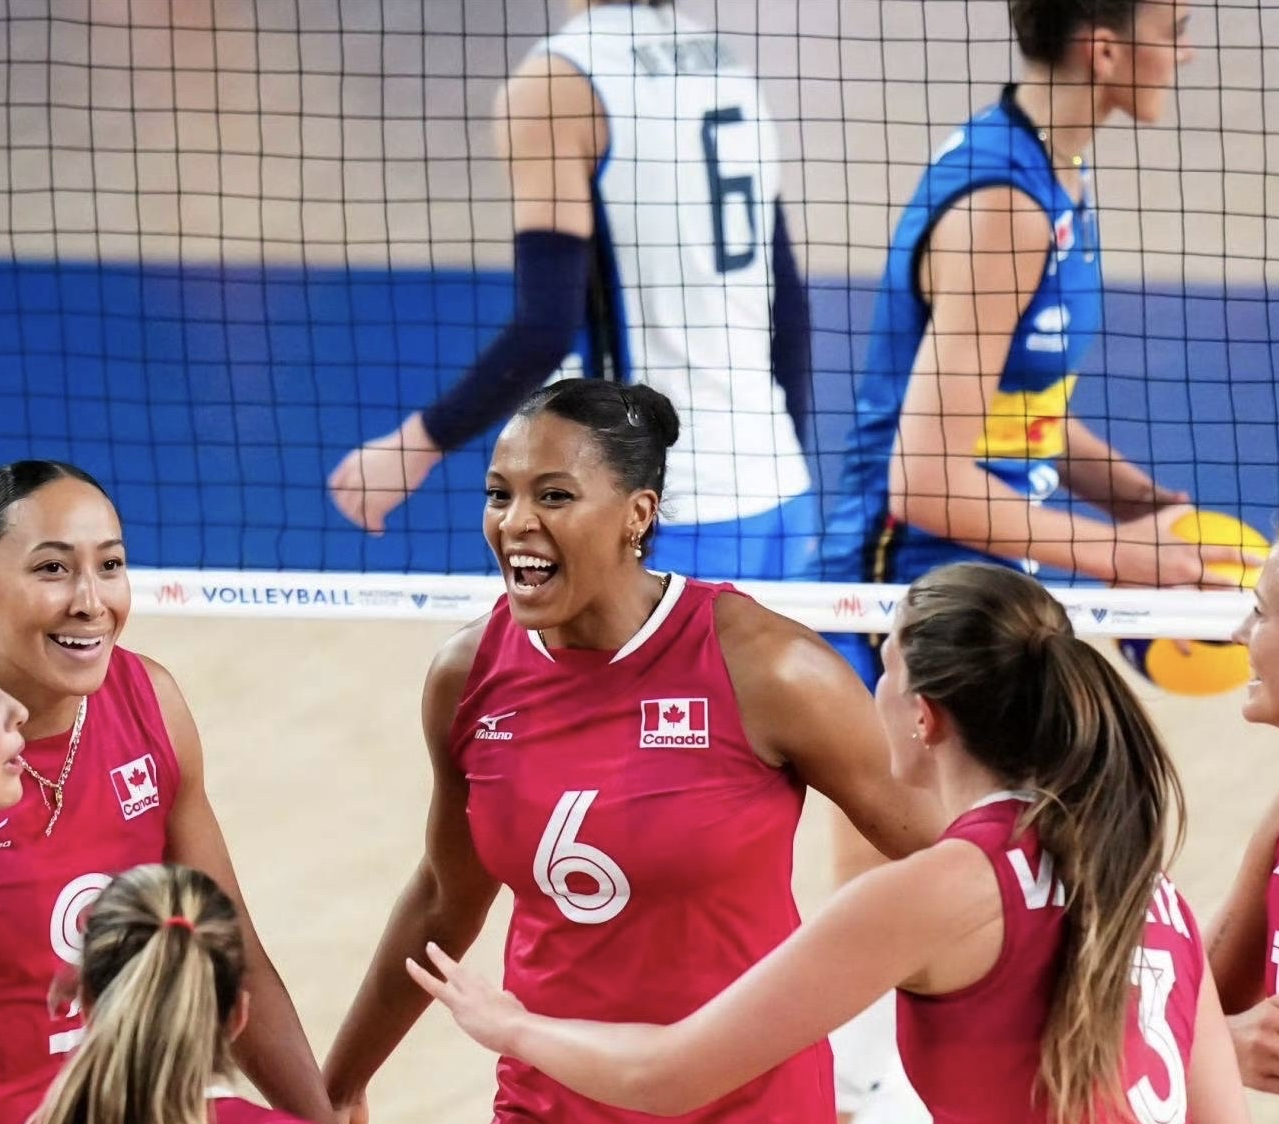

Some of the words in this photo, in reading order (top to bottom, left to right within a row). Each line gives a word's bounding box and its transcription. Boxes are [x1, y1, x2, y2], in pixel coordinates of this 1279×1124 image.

[701, 104, 757, 275] 6
[201, 586, 355, 606] VOLLEYBALL
[642, 733, 707, 746] Canada
[532, 789, 631, 925] 6
